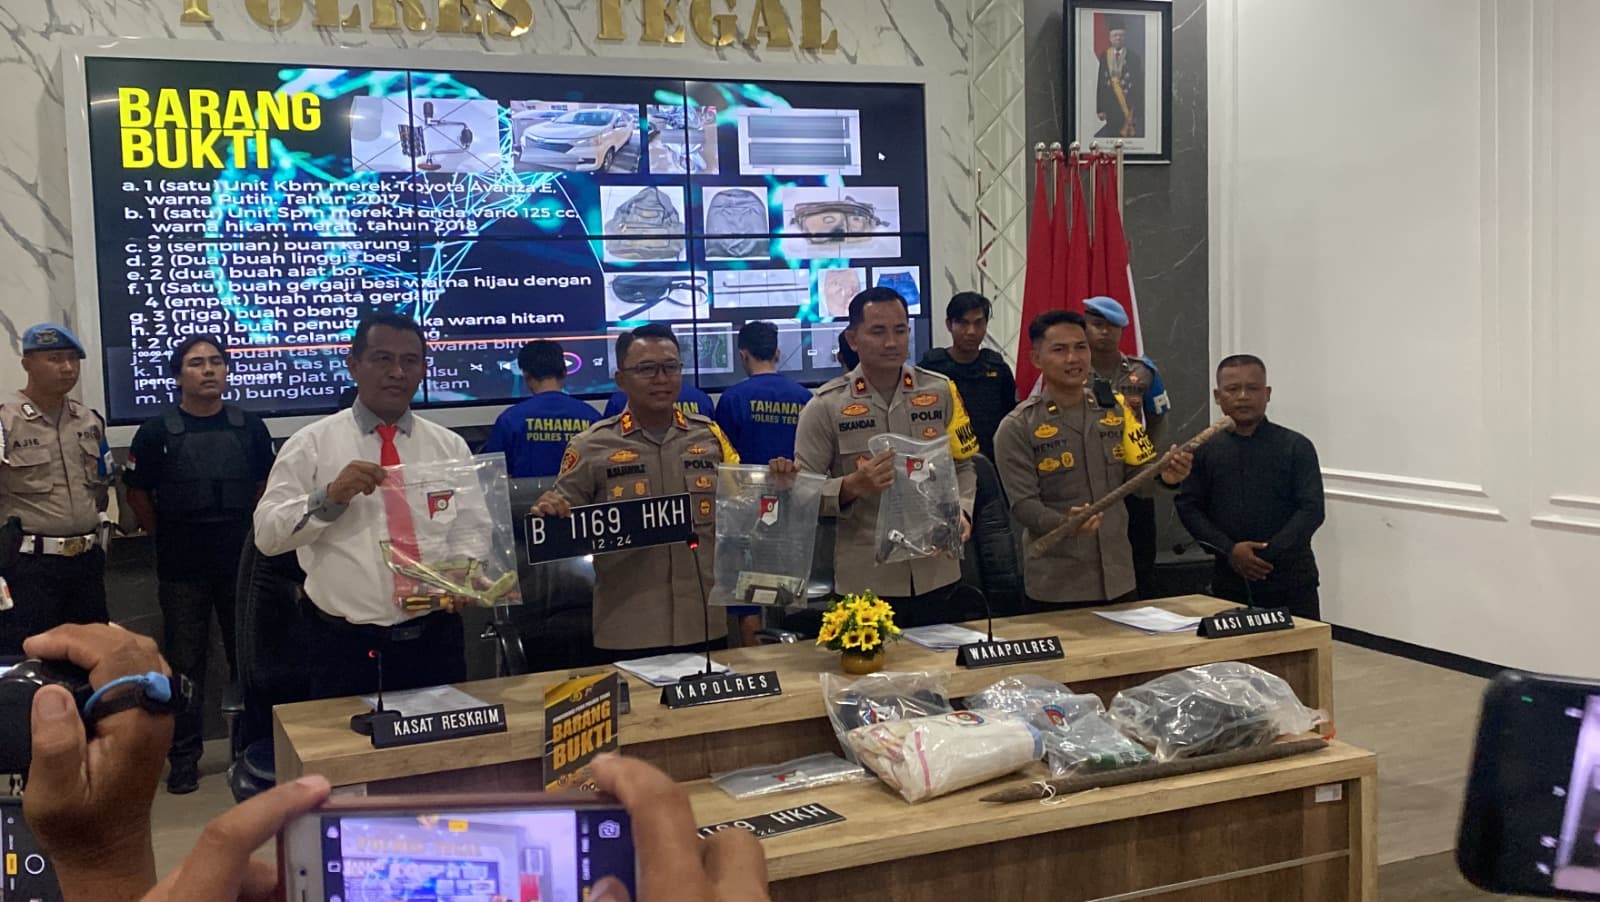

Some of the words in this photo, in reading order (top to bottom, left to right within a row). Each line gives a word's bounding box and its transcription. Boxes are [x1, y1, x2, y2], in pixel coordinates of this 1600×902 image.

[118, 87, 322, 131] BARANG
[121, 127, 270, 169] BUKTI
[122, 181, 140, 192] a.
[144, 180, 153, 192] 1
[159, 179, 221, 193] (satu)
[225, 180, 268, 192] Unit
[274, 180, 322, 192] Kbm
[329, 180, 392, 192] merek
[396, 181, 465, 194] Toyota
[145, 194, 212, 206] warna
[283, 193, 347, 205] Tahun
[124, 207, 144, 219] b.
[147, 207, 156, 219] 1
[163, 206, 223, 220] (satu)
[228, 206, 271, 218] Unit
[277, 206, 324, 220] Spm
[331, 206, 393, 218] merek
[522, 207, 551, 218] 125
[152, 222, 219, 233] warna
[226, 220, 287, 232] hitam
[434, 219, 478, 231] 2018
[125, 243, 142, 253] c.
[148, 235, 161, 253] 9
[126, 255, 146, 267] d.
[151, 255, 164, 266] 2
[170, 253, 227, 267] (Dua)
[232, 253, 286, 265] buah
[292, 252, 358, 266] linggis
[363, 251, 401, 263] besi
[127, 270, 145, 281] e.
[150, 269, 163, 280] 2
[169, 267, 224, 281] (dua)
[229, 266, 282, 279] buah
[288, 266, 325, 277] alat
[332, 264, 363, 276] bor
[128, 283, 140, 295] f.
[145, 283, 153, 294] 1
[160, 282, 223, 296] (Satu)
[229, 281, 281, 293] buah
[287, 278, 355, 294] gergaji
[361, 277, 400, 289] besi
[474, 275, 519, 289] hijau
[523, 274, 592, 290] dengan
[145, 297, 159, 308] 4
[165, 295, 249, 310] (empat)
[254, 293, 306, 305] buah
[313, 292, 364, 303] mata
[129, 312, 148, 325] g.
[153, 310, 165, 322] 3
[171, 309, 230, 323] (Tiga)
[236, 306, 288, 318] buah
[293, 305, 358, 318] obeng
[131, 324, 150, 336] h.
[155, 324, 168, 335] 2
[174, 322, 230, 336] (dua)
[235, 320, 287, 333] buah
[448, 315, 507, 326] warna
[512, 312, 565, 324] hitam
[147, 337, 161, 349] 2
[227, 333, 279, 345] buah
[284, 331, 352, 344] celana
[134, 365, 150, 377] k.
[156, 365, 163, 376] 1
[235, 360, 287, 372] buah
[293, 359, 323, 370] tas
[288, 371, 328, 386] plat
[136, 395, 161, 405] m.
[166, 392, 174, 403] 1
[246, 385, 335, 399] bungkus
[525, 417, 590, 432] TAHANAN
[911, 409, 943, 422] POLRI
[526, 432, 562, 441] POLRES
[531, 517, 546, 545] B
[570, 507, 622, 540] 1169
[641, 498, 686, 529] HKH
[1213, 616, 1242, 631] KASI
[1246, 610, 1286, 627] HUMAS
[969, 639, 1056, 661] WAKAPOLRES
[675, 674, 768, 700] KAPOLRES
[393, 716, 434, 737] KASAT
[441, 708, 500, 731] RESKRIM
[552, 700, 611, 744] BARANG
[553, 719, 612, 770] BUKTI
[770, 804, 829, 825] HKH
